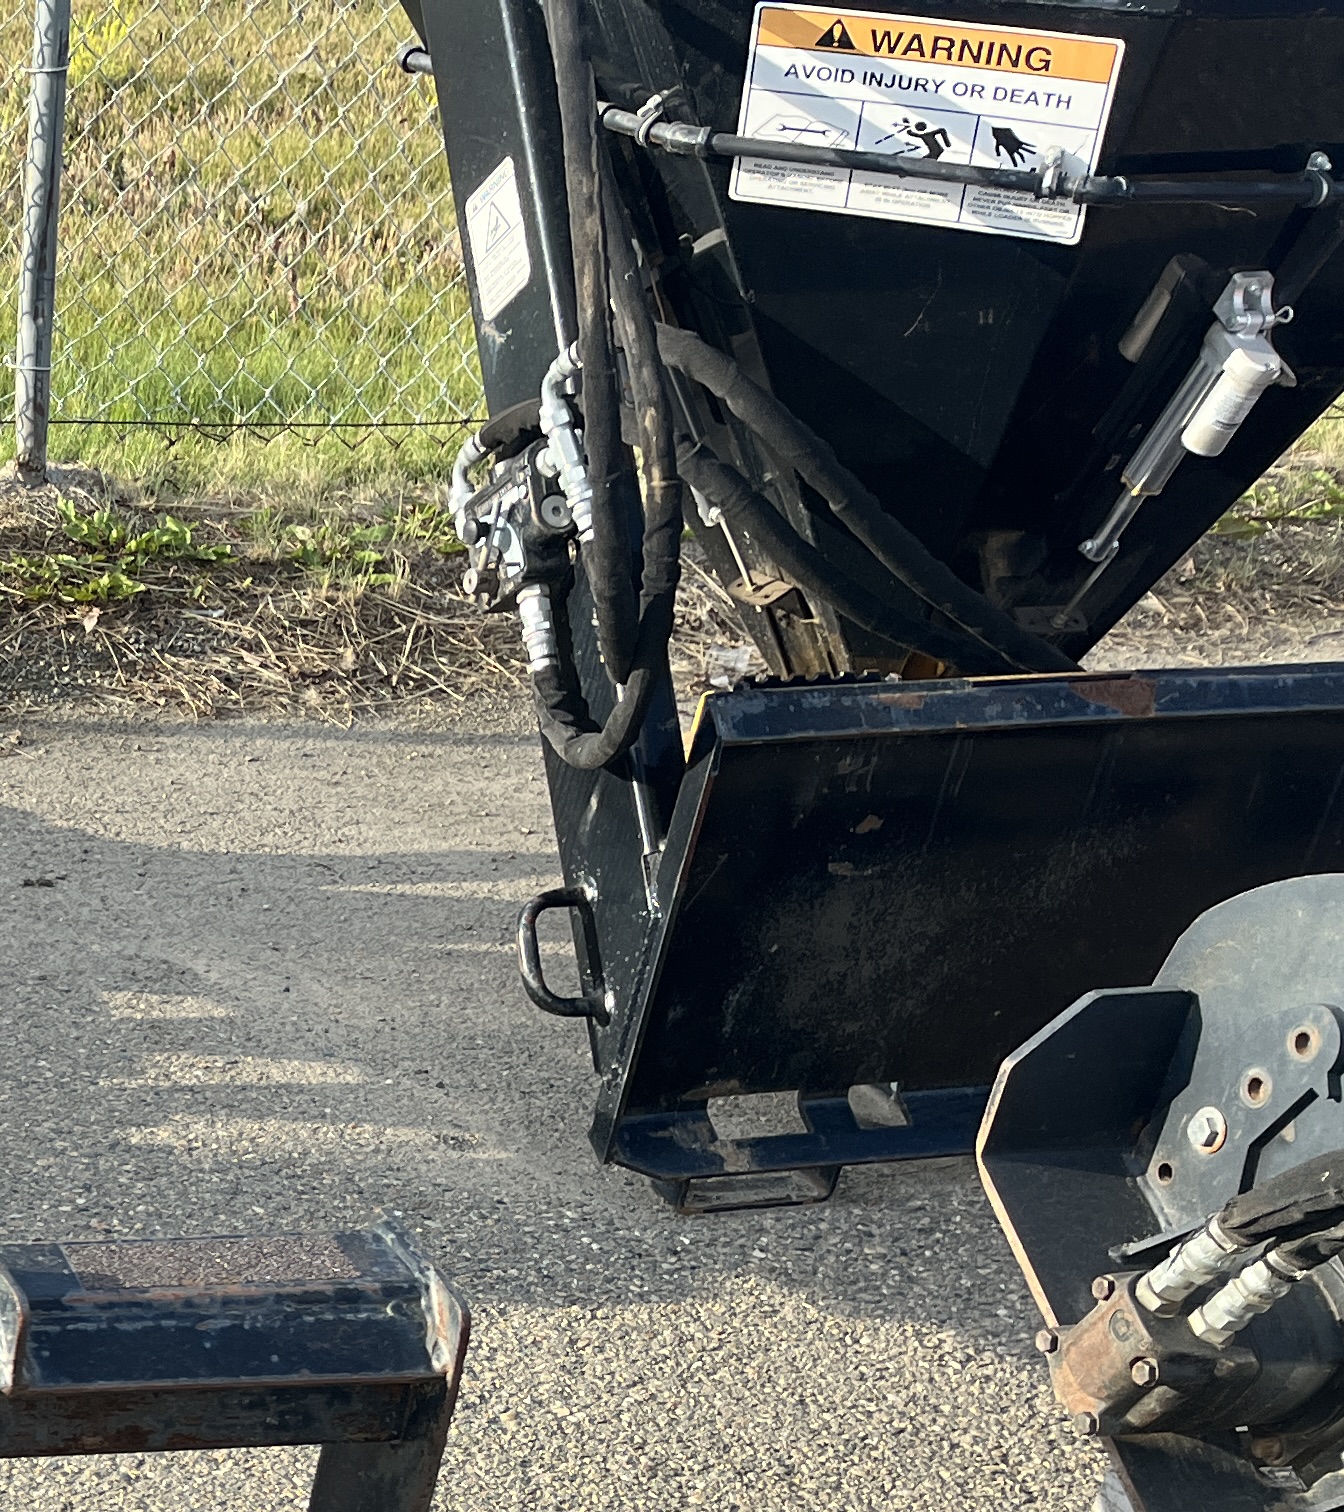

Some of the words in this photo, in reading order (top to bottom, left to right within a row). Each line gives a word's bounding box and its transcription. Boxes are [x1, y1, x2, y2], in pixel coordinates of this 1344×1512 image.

[871, 28, 1052, 72] WARNING
[784, 63, 855, 84] AVOID
[862, 71, 946, 94] INJURY
[952, 81, 985, 99] OR
[993, 87, 1072, 110] DEATH
